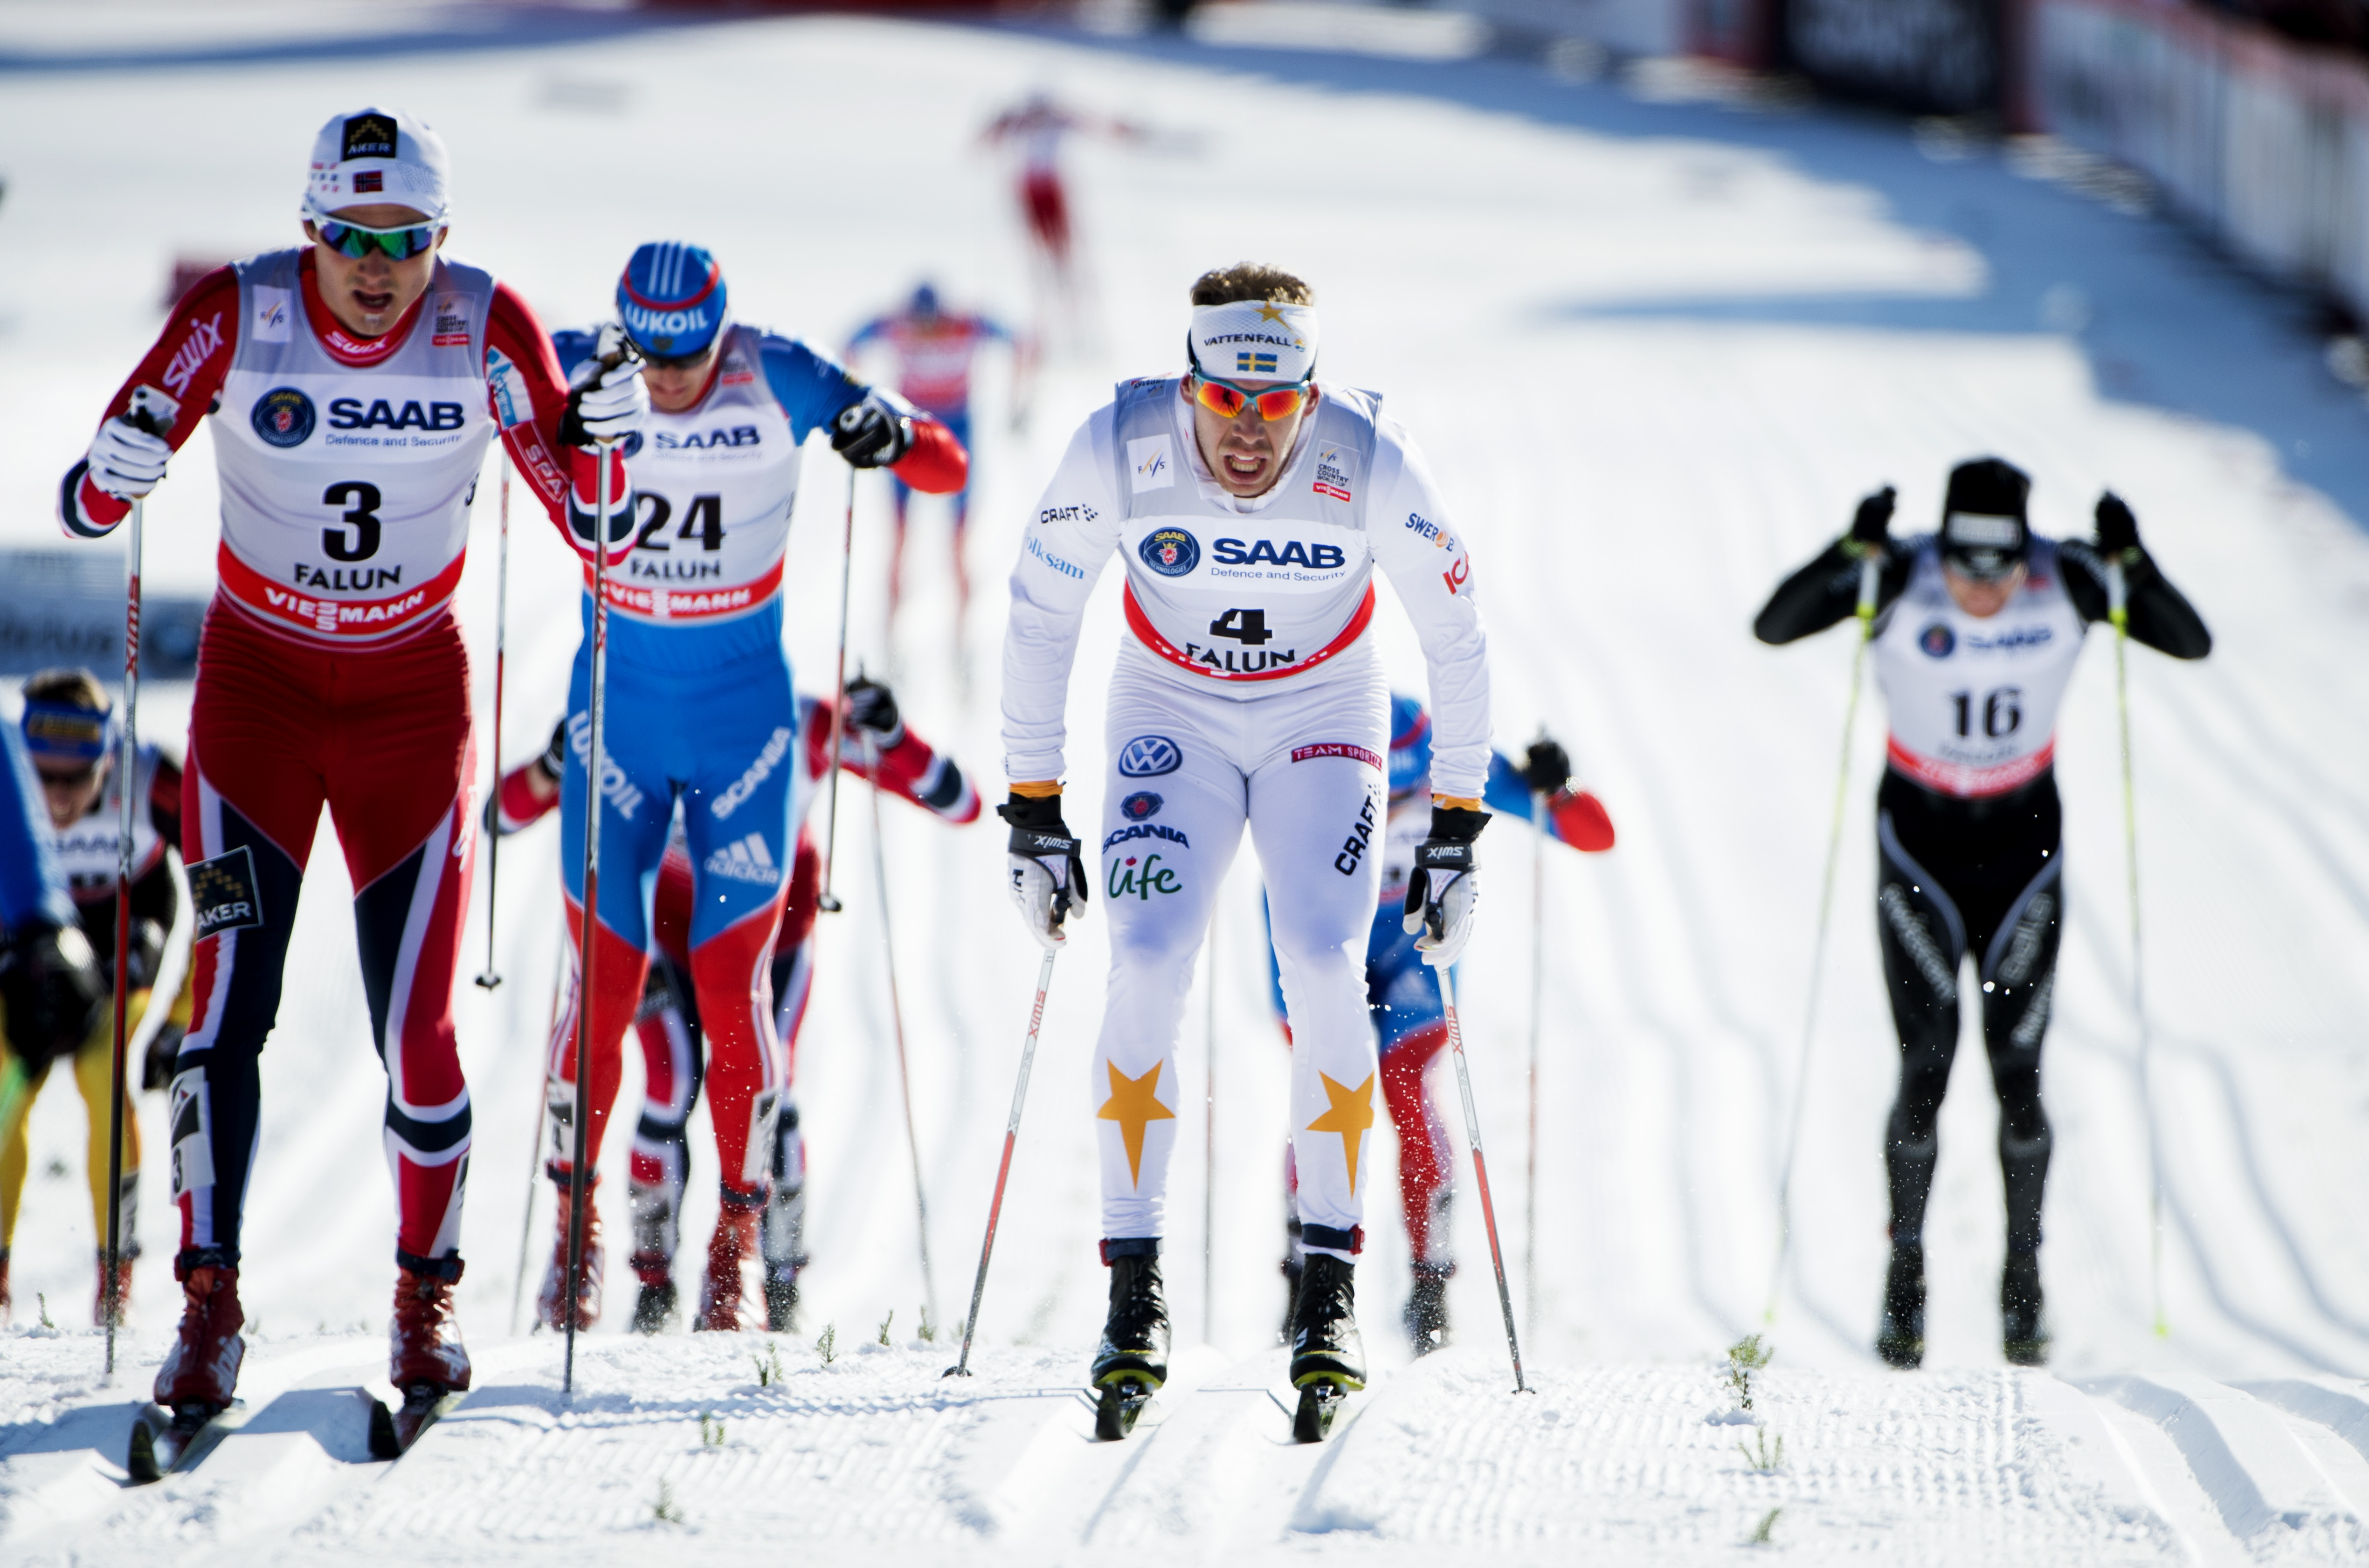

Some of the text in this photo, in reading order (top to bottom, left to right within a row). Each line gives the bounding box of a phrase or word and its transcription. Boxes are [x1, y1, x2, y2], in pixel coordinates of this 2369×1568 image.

[1204, 334, 1291, 346] VATTENFALL
[328, 398, 465, 430] SAAB
[326, 434, 462, 447] Defence and Security
[656, 426, 760, 449] SAAB
[1318, 469, 1349, 483] COUNTRY
[1319, 464, 1340, 475] CROSS
[322, 480, 381, 561] 3
[636, 491, 728, 551] 24
[1041, 507, 1079, 524] CRAFT
[1154, 532, 1185, 542] SAAB
[1026, 536, 1084, 579] olksam
[1149, 560, 1186, 574] TECHNOLOGIES
[1212, 538, 1345, 569] SAAB
[294, 563, 401, 591] FALUN
[630, 559, 720, 580] FALUN
[1211, 567, 1346, 581] Defence and Security
[265, 586, 425, 631] VIESSMANN
[1209, 608, 1273, 645] 4
[1186, 642, 1295, 673] FALUN
[1951, 688, 2023, 738] 16
[1294, 746, 1341, 759] TEAM
[711, 726, 791, 821] SCANIA
[1334, 795, 1377, 875] CRAFT
[704, 856, 780, 885] adidas
[1109, 854, 1182, 901] life
[197, 901, 252, 929] AKER
